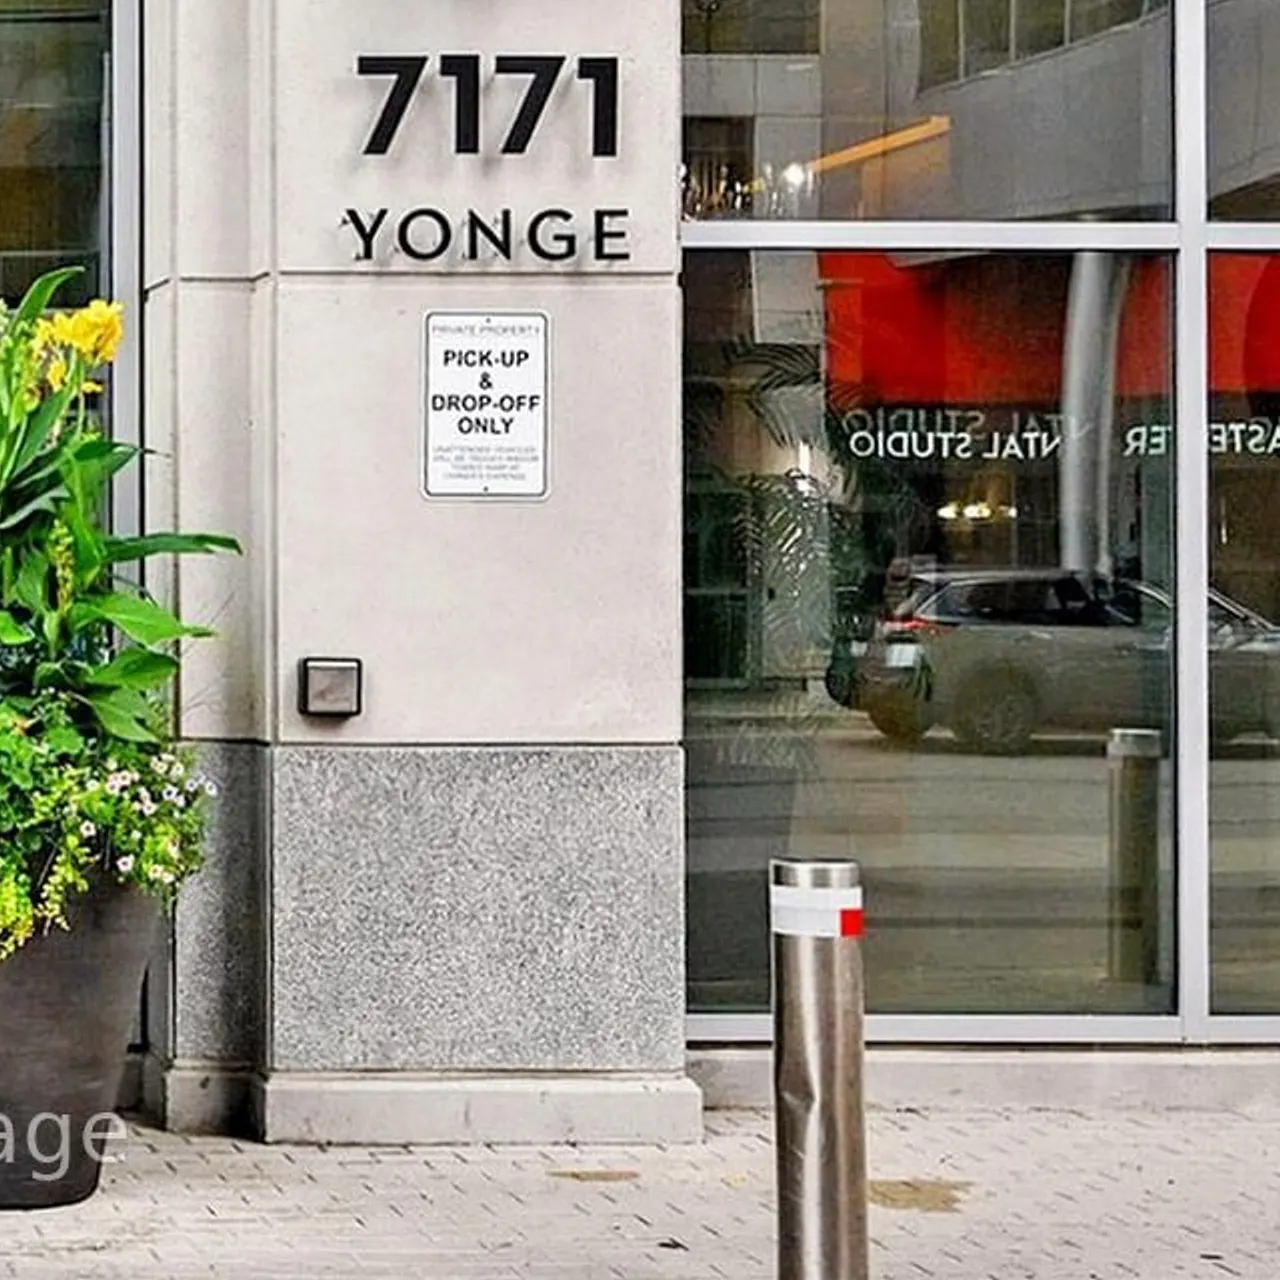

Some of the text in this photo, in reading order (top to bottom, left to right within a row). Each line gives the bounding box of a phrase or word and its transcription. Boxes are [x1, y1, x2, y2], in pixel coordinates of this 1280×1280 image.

[357, 54, 618, 157] 7171
[346, 208, 630, 261] YONGE
[443, 349, 530, 367] PICK-UP
[478, 372, 493, 390] &
[431, 393, 540, 412] DROP-OFF
[457, 416, 515, 435] ONLY
